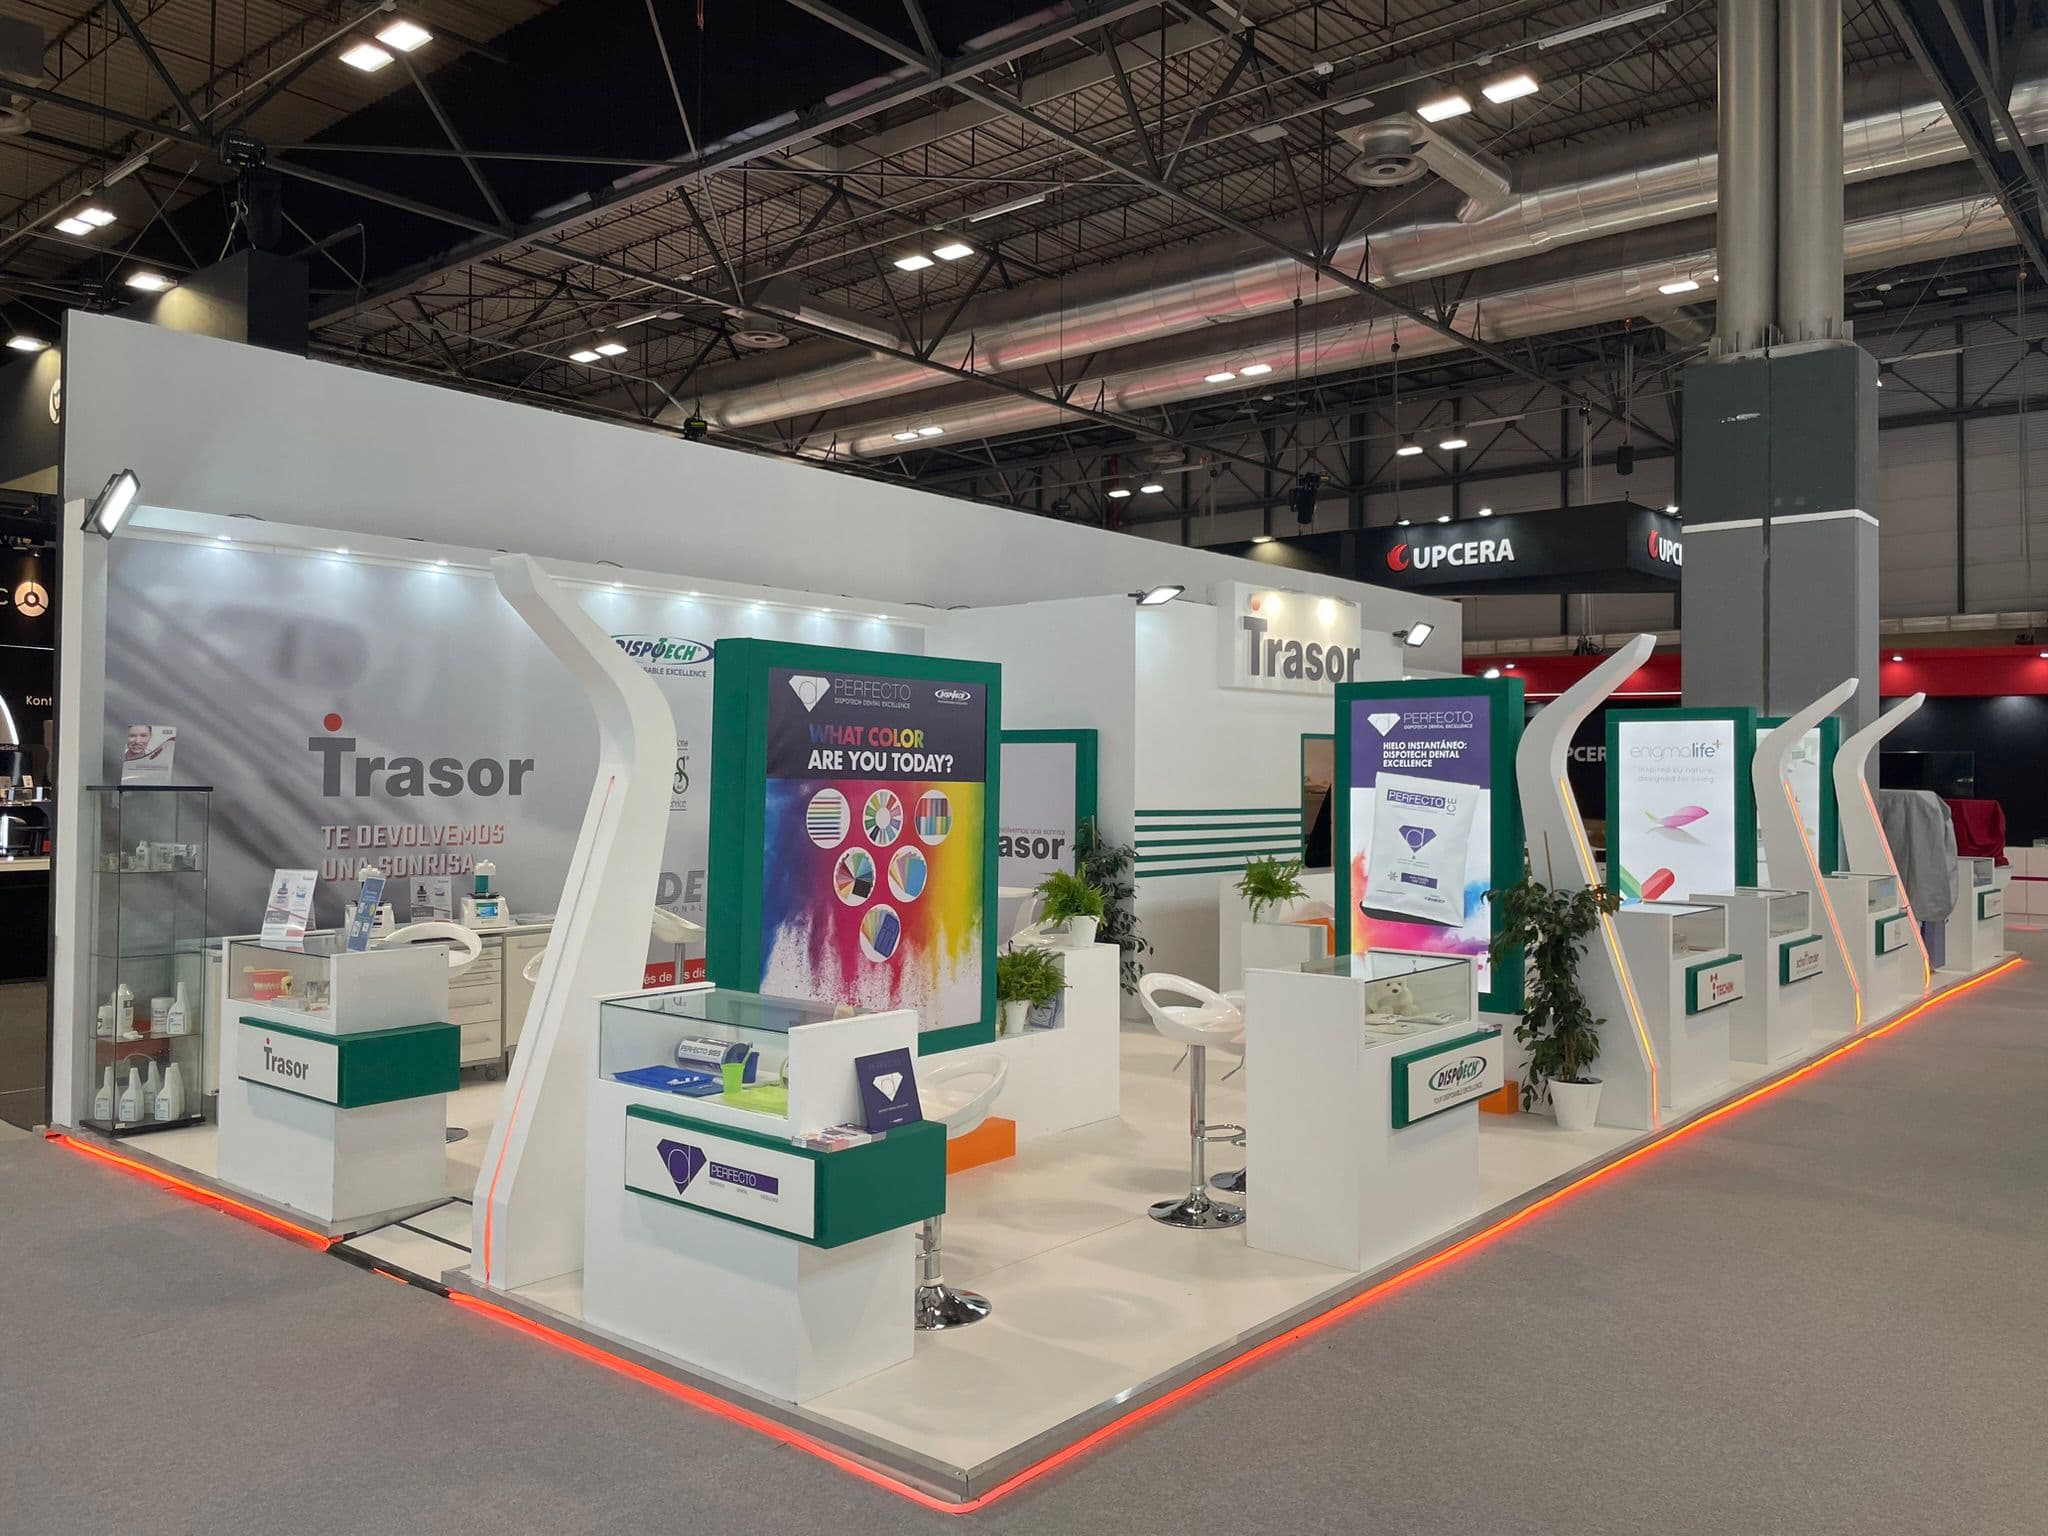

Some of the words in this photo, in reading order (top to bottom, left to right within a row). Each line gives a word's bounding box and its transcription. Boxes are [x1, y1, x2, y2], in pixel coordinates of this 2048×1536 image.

[1413, 538, 1515, 570] UPCERA
[1243, 615, 1361, 683] Trasor
[666, 668, 708, 678] EXCELLENCE
[834, 678, 911, 701] PERFECTO
[1403, 710, 1474, 724] PERFECTO
[809, 722, 865, 746] WHAT
[867, 726, 925, 749] COLOR
[1383, 741, 1406, 750] HIELO
[1407, 739, 1468, 750] INSTANTÁNEO:
[808, 749, 844, 771] ARE
[849, 750, 888, 772] YOU
[892, 752, 954, 774] TODAY?
[1383, 750, 1427, 759] DISPOTECH
[1429, 750, 1460, 759] DENTAL
[1383, 759, 1433, 768] EXCELLENCE
[308, 736, 535, 798] Trasor
[1388, 790, 1445, 808] PERFECTO
[321, 825, 350, 850] TE
[356, 823, 505, 849] DEVOLVEMOS
[998, 836, 1065, 860] asor
[322, 855, 368, 881] UNA
[378, 852, 474, 879] SONRISA
[659, 971, 673, 983] de
[264, 1046, 309, 1081] Trasor
[711, 1164, 757, 1187] PERFECTO
